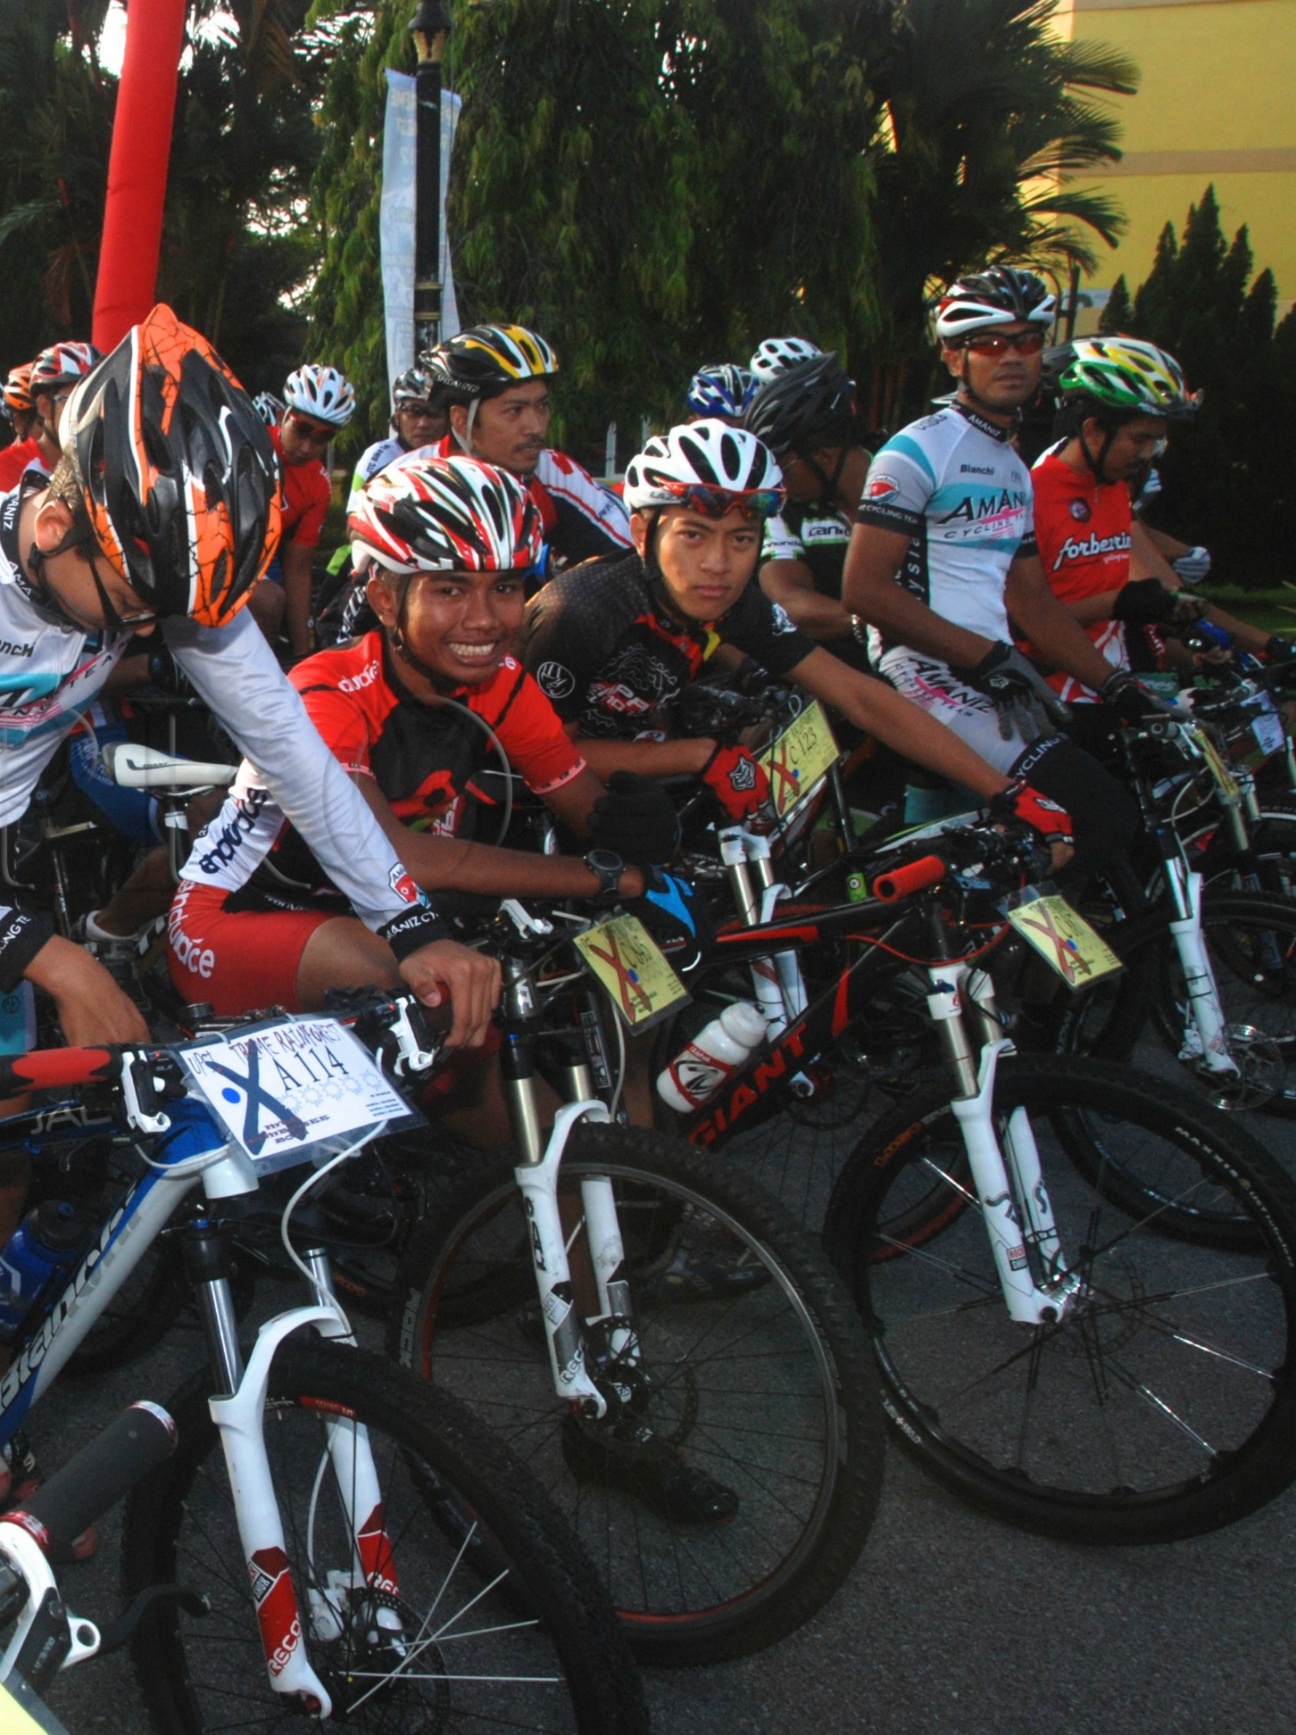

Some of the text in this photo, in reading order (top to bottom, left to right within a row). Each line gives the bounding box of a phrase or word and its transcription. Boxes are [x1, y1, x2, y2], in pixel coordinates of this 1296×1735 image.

[436, 374, 480, 393] SPECIALIZED
[968, 414, 1002, 438] AMANIZ
[960, 464, 995, 476] Bianchi
[935, 489, 1027, 524] AMAN
[909, 657, 993, 714] AMANIZ
[687, 1022, 808, 1150] GIANT
[1174, 1126, 1239, 1178] MAXXIS
[560, 1341, 585, 1385] REC
[267, 1611, 301, 1679] RECO
